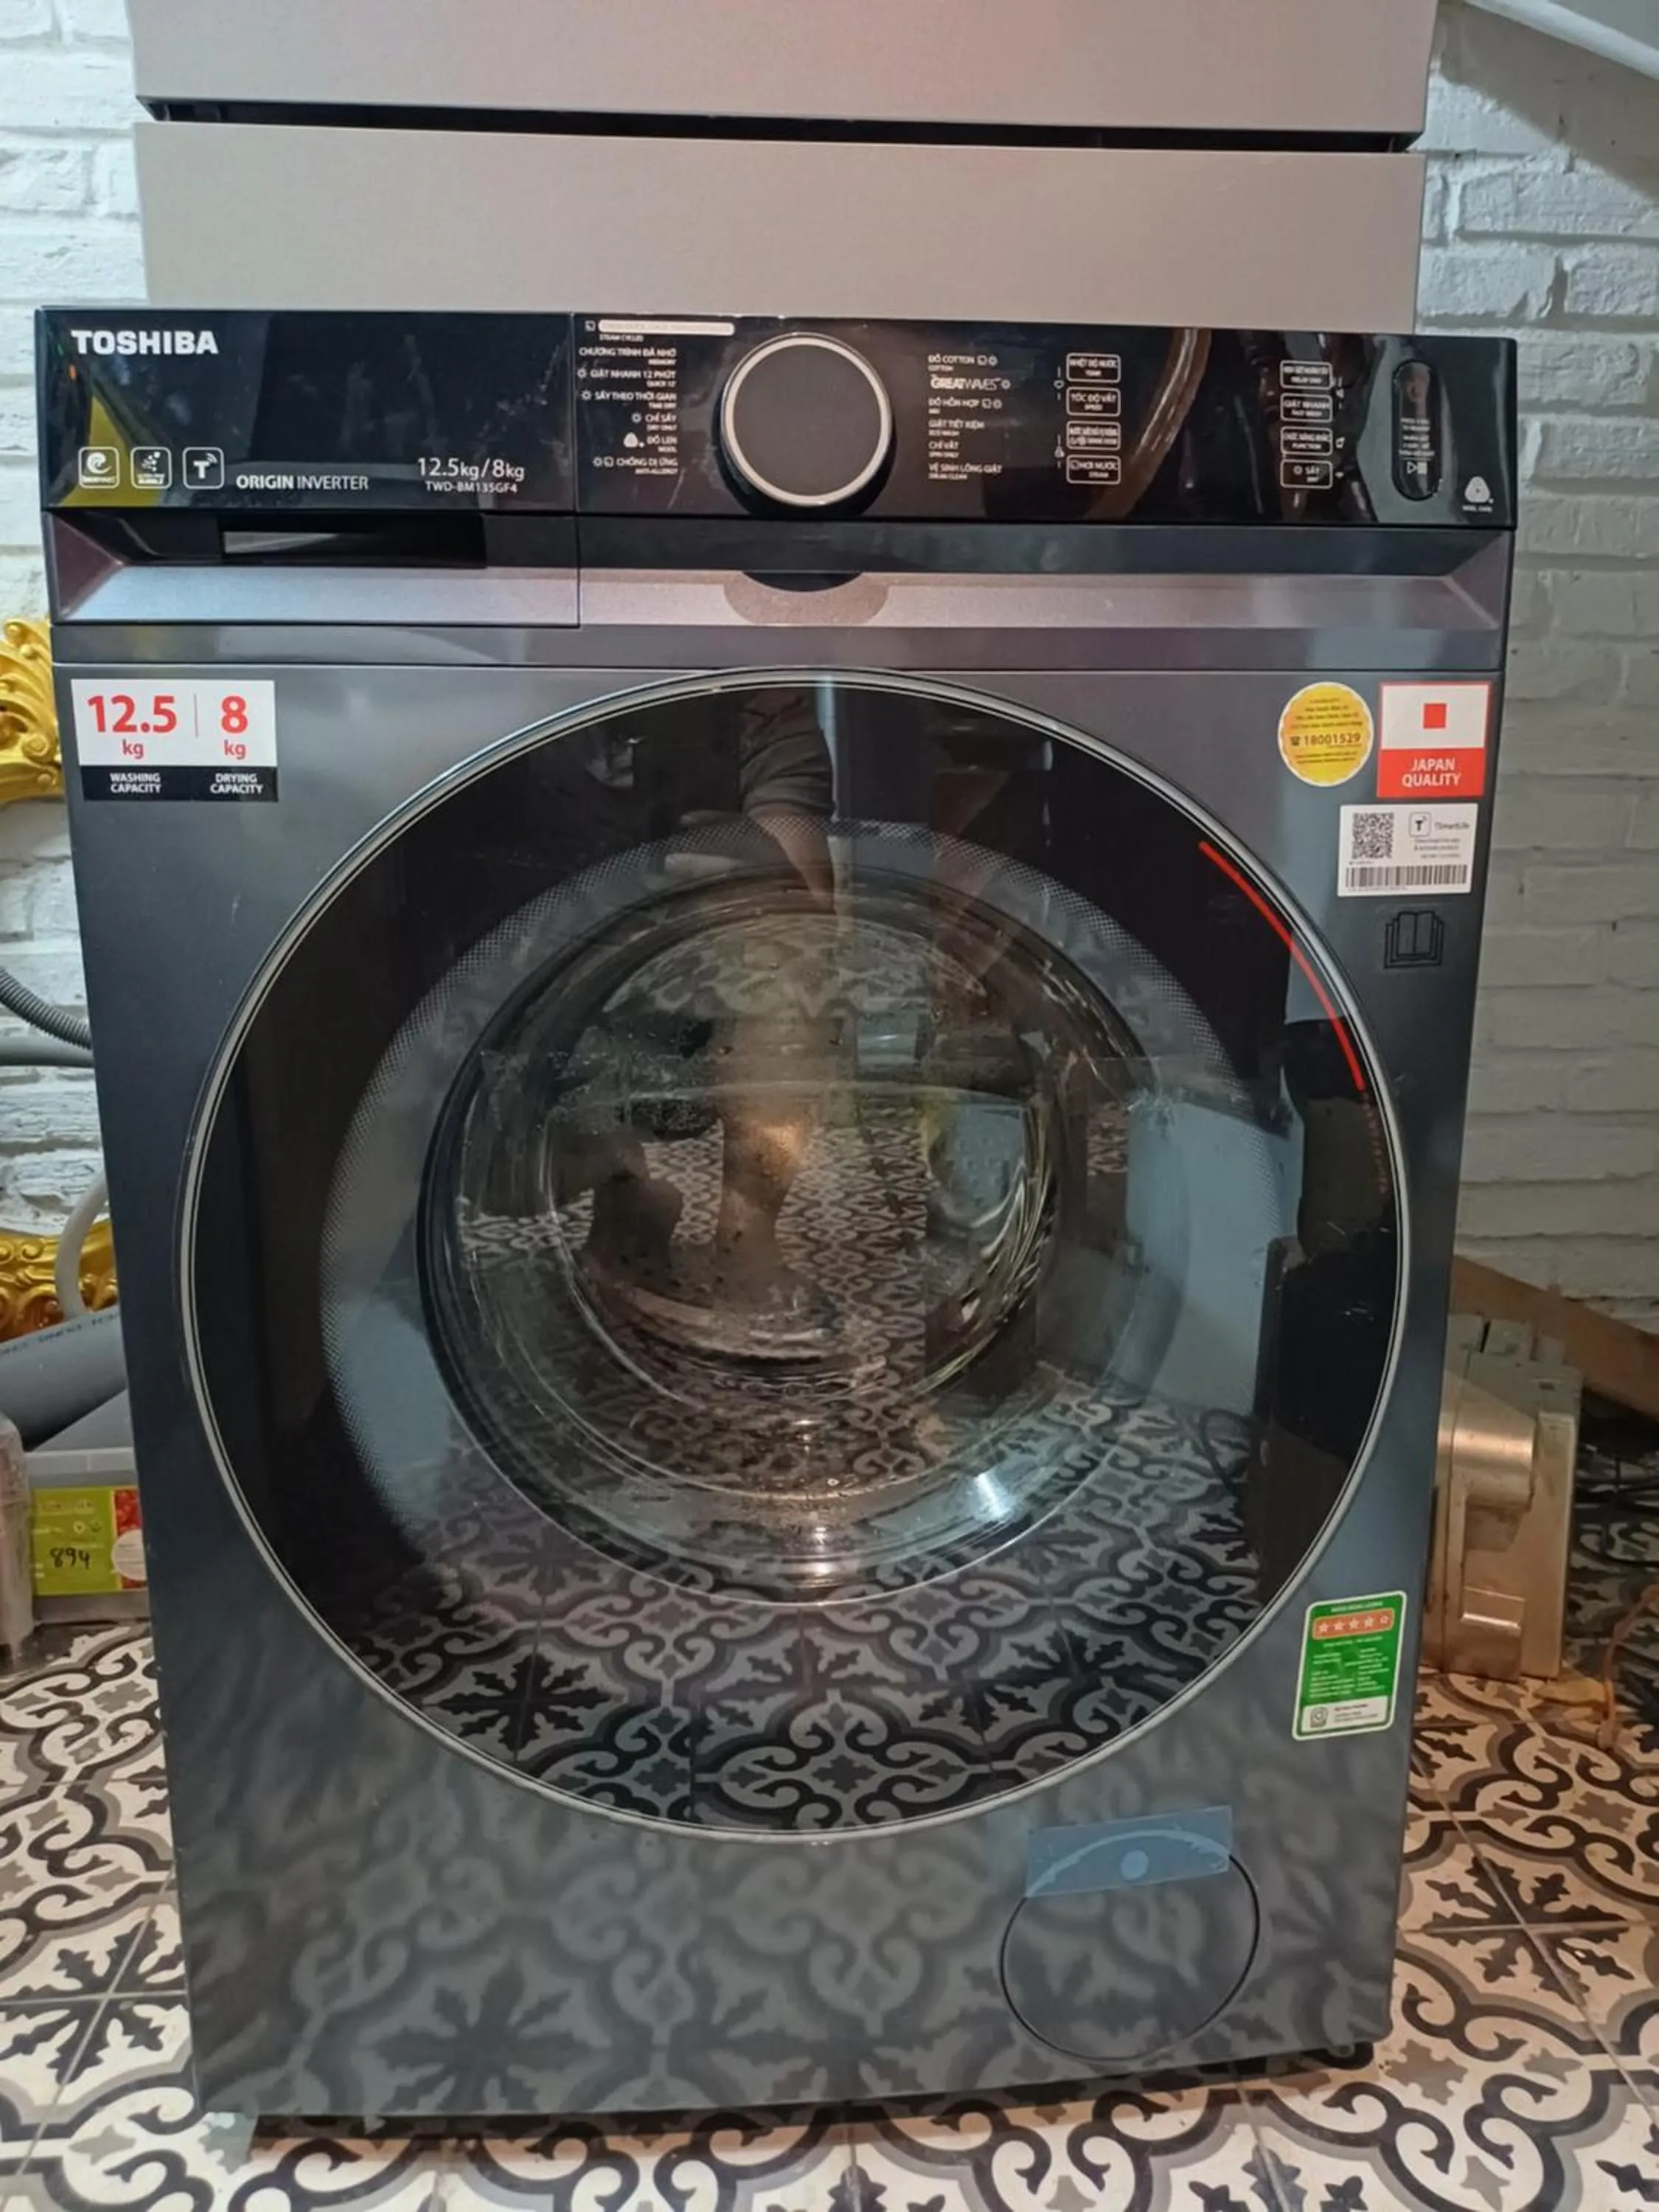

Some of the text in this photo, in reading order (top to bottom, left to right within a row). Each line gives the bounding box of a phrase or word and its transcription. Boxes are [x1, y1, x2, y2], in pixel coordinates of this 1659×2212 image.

[72, 330, 218, 355] TOSHIBA
[237, 475, 369, 490] ORIGIN INVERTER
[87, 695, 248, 733] 12.5 8
[1304, 733, 1361, 745] 18001529
[122, 739, 144, 759] kg
[224, 740, 246, 759] kg
[1412, 757, 1455, 771] JAPAN
[110, 773, 161, 783] WASHING
[215, 773, 257, 783] DRYING
[1402, 773, 1462, 787] QUALITY
[111, 784, 161, 793] CAPACITY
[210, 784, 263, 794] CAPACITY
[49, 1547, 90, 1569] 894
